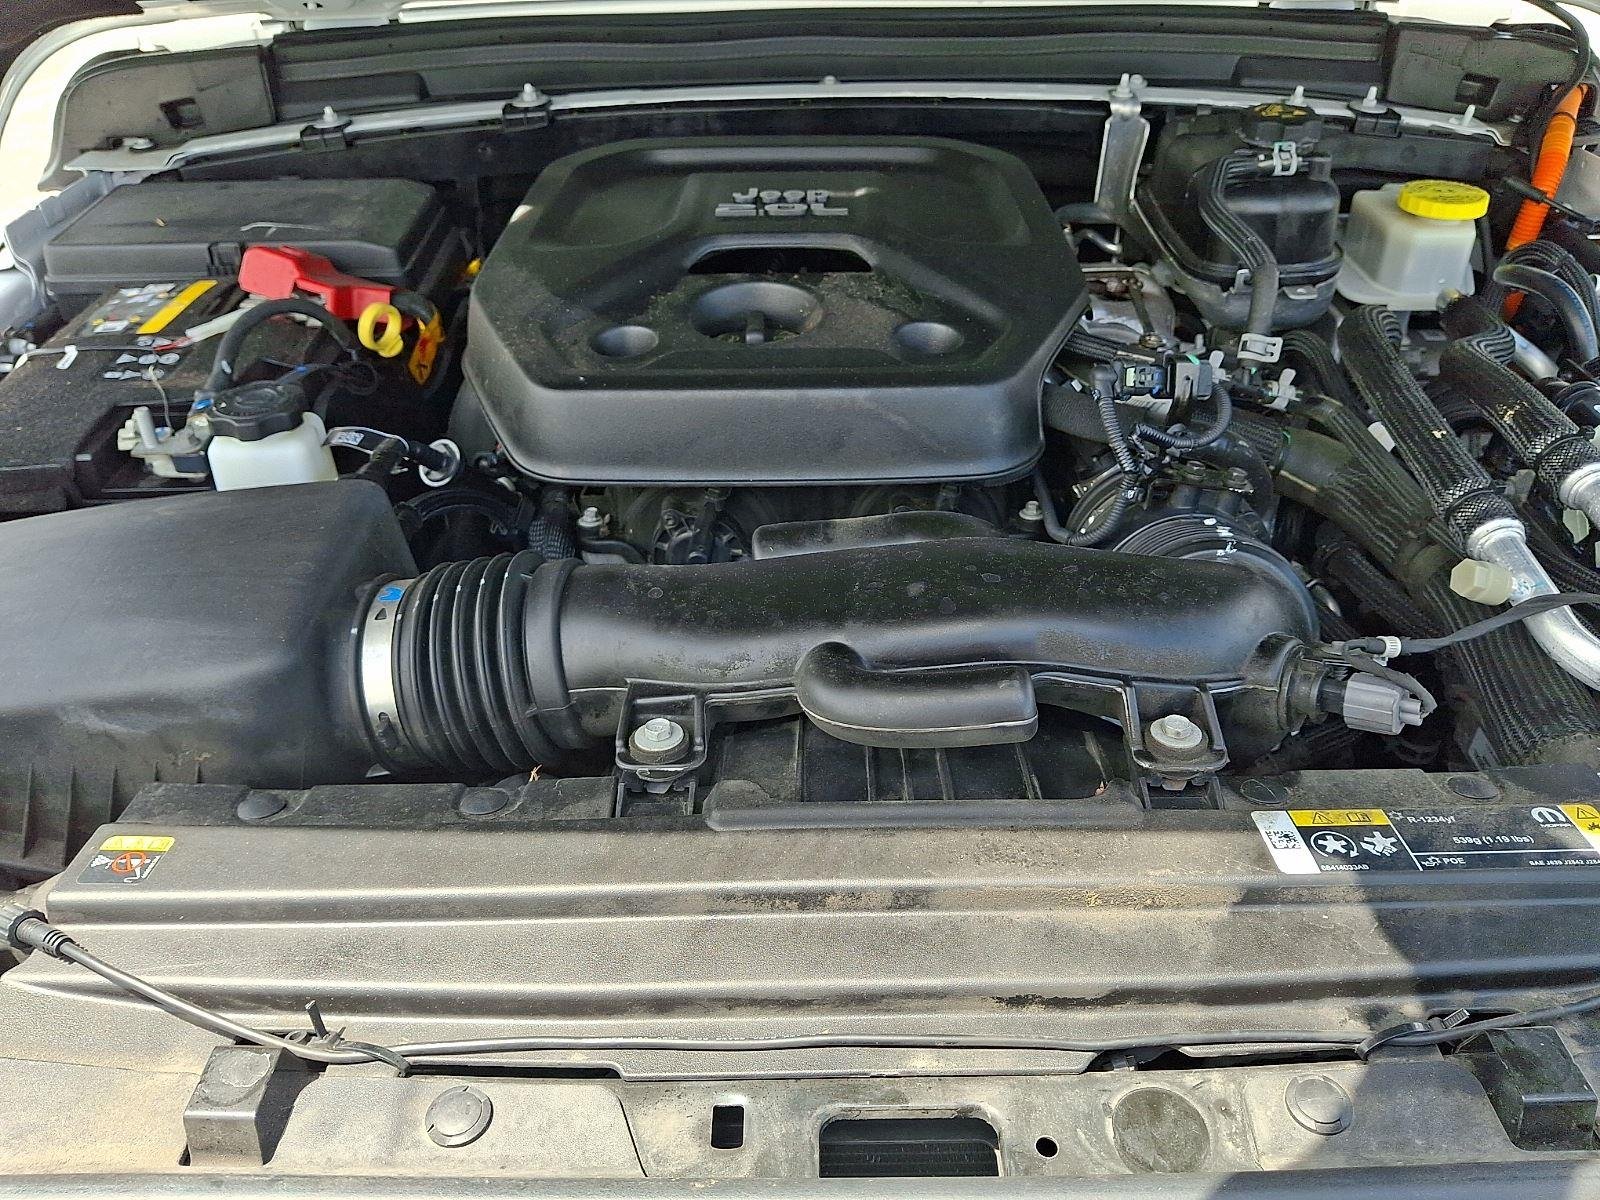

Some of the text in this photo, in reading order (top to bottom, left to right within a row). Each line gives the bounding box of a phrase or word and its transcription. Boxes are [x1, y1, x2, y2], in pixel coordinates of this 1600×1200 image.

[732, 187, 831, 204] Jeep
[1407, 815, 1456, 824] R-1234yf
[1452, 835, 1535, 845] 539g (1.19 lbs)
